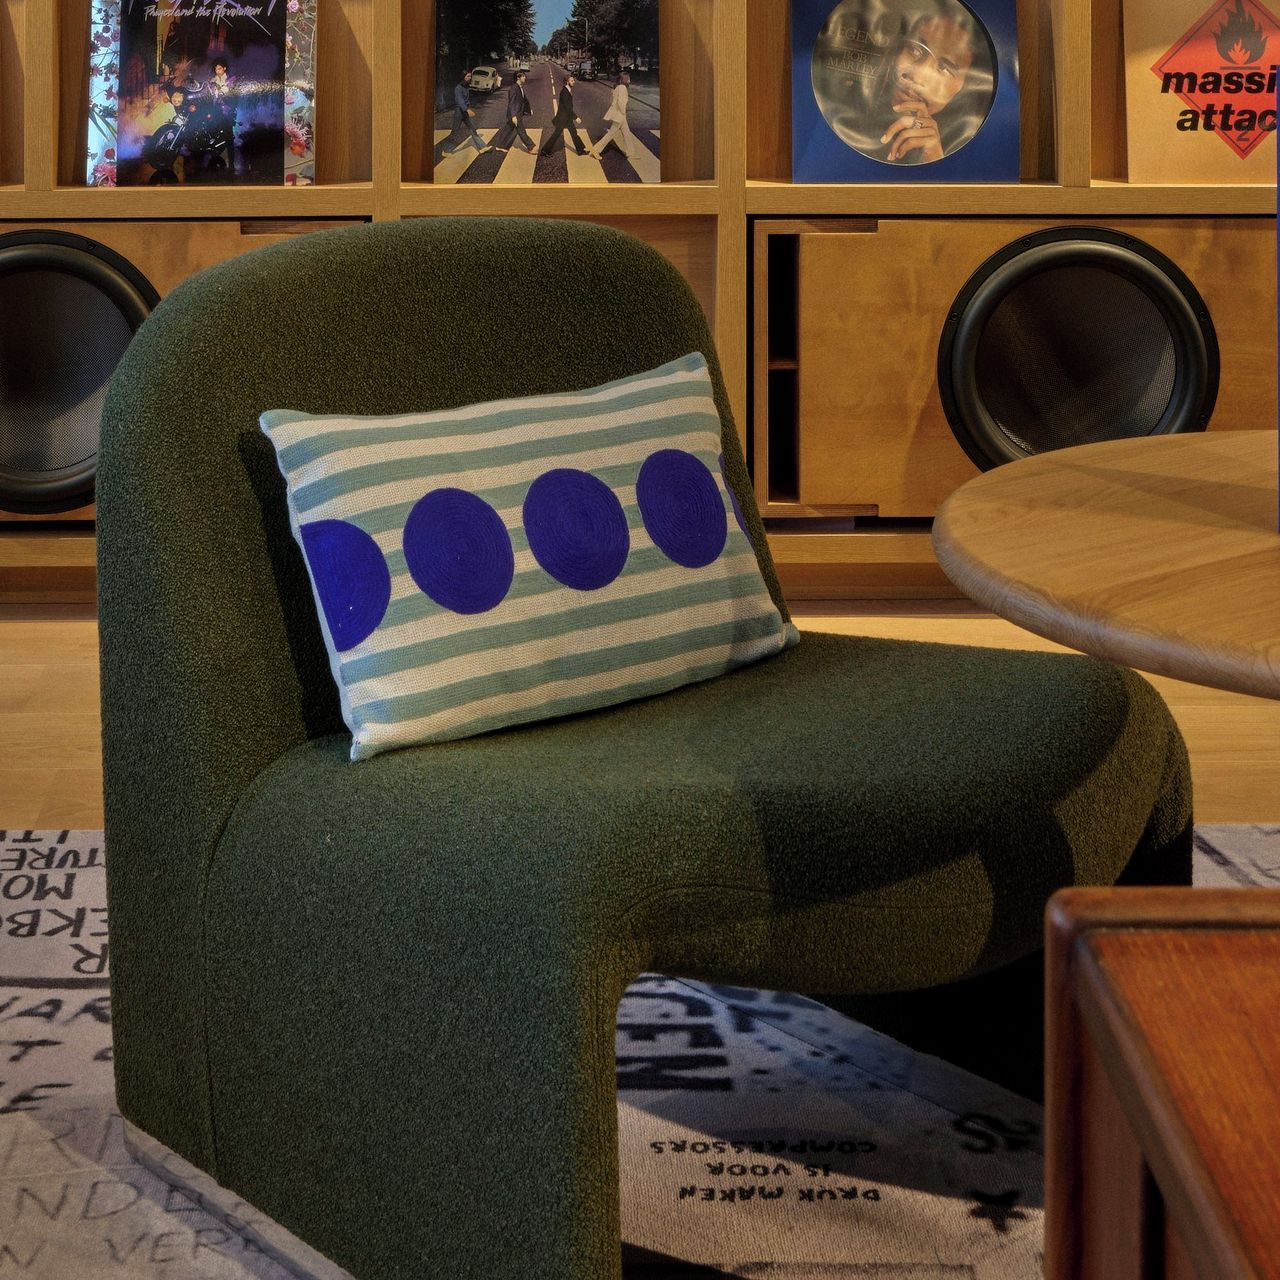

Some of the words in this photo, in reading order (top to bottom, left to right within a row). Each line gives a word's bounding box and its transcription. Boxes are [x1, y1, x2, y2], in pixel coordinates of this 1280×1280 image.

[1160, 64, 1277, 94] massi
[1176, 103, 1277, 132] attac
[649, 1141, 878, 1156] COMPRESSORS
[706, 1162, 792, 1177] VOOR
[679, 1186, 785, 1203] MAKEN
[799, 1188, 881, 1203] DRUK
